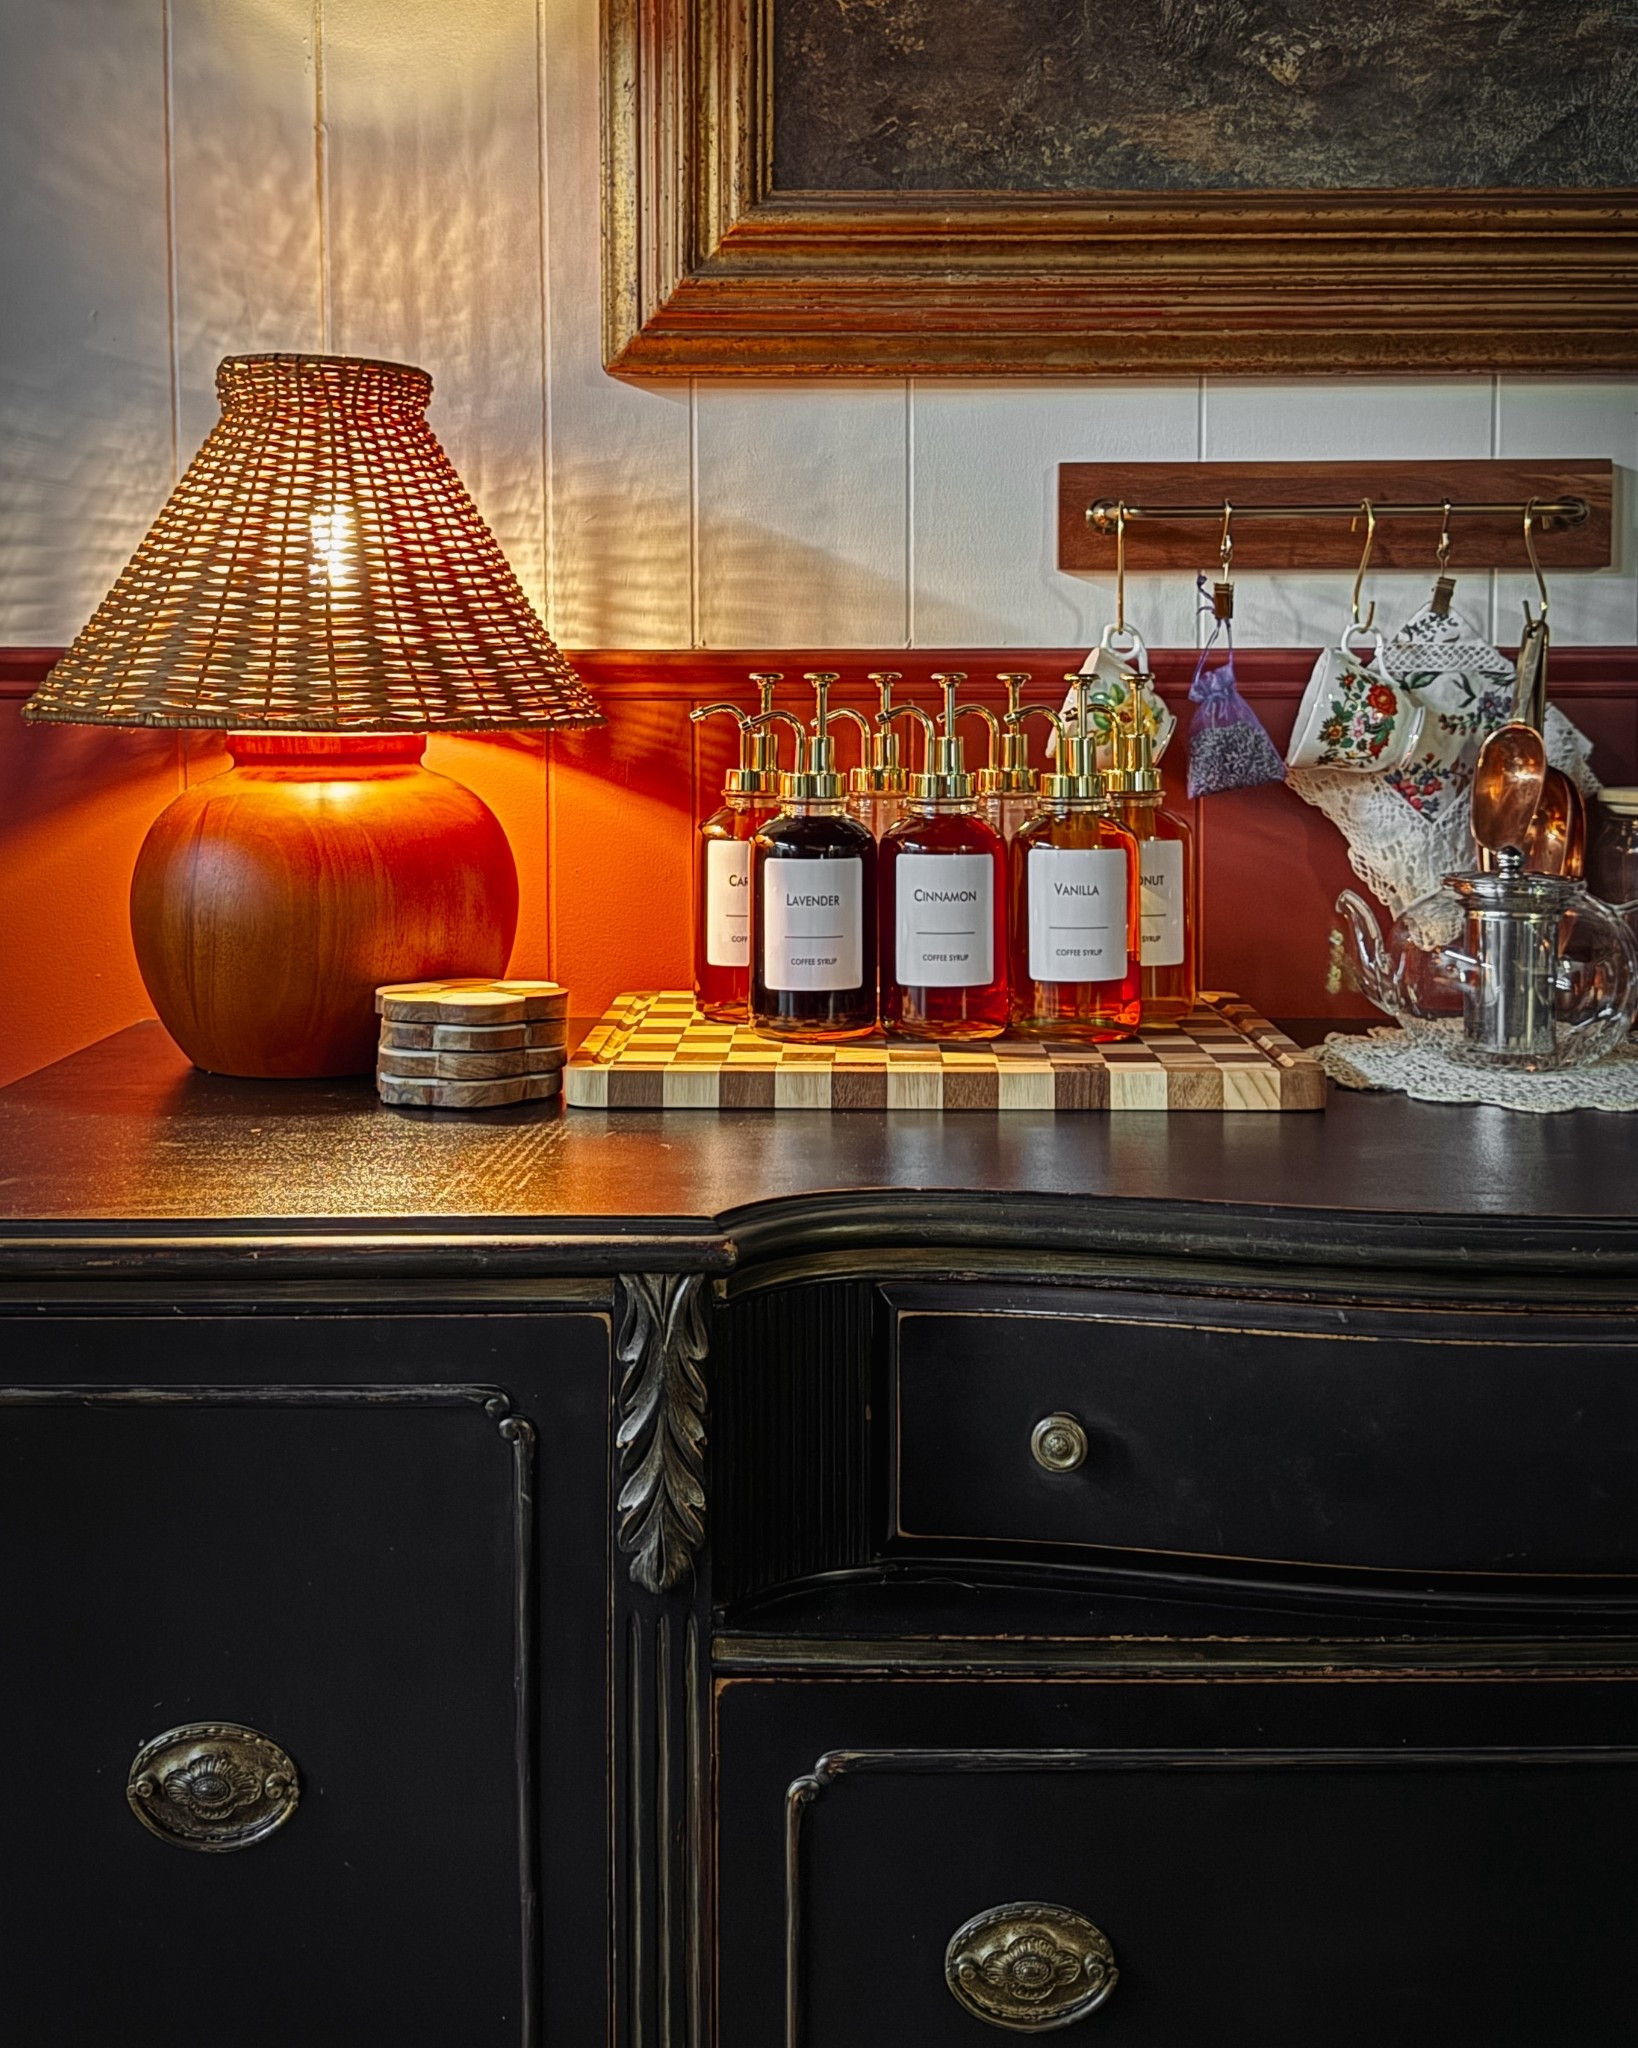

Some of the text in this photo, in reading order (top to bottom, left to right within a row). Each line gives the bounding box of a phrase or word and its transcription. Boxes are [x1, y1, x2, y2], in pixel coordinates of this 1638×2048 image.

[1054, 883, 1100, 896] VANILLA
[786, 893, 840, 906] LAVENDER
[914, 889, 977, 902] CINNAMON
[922, 954, 969, 962] COFFEE SYRUP
[1055, 949, 1103, 957] COFFEE SYRUP
[790, 958, 837, 966] COFFEE SYRUP
